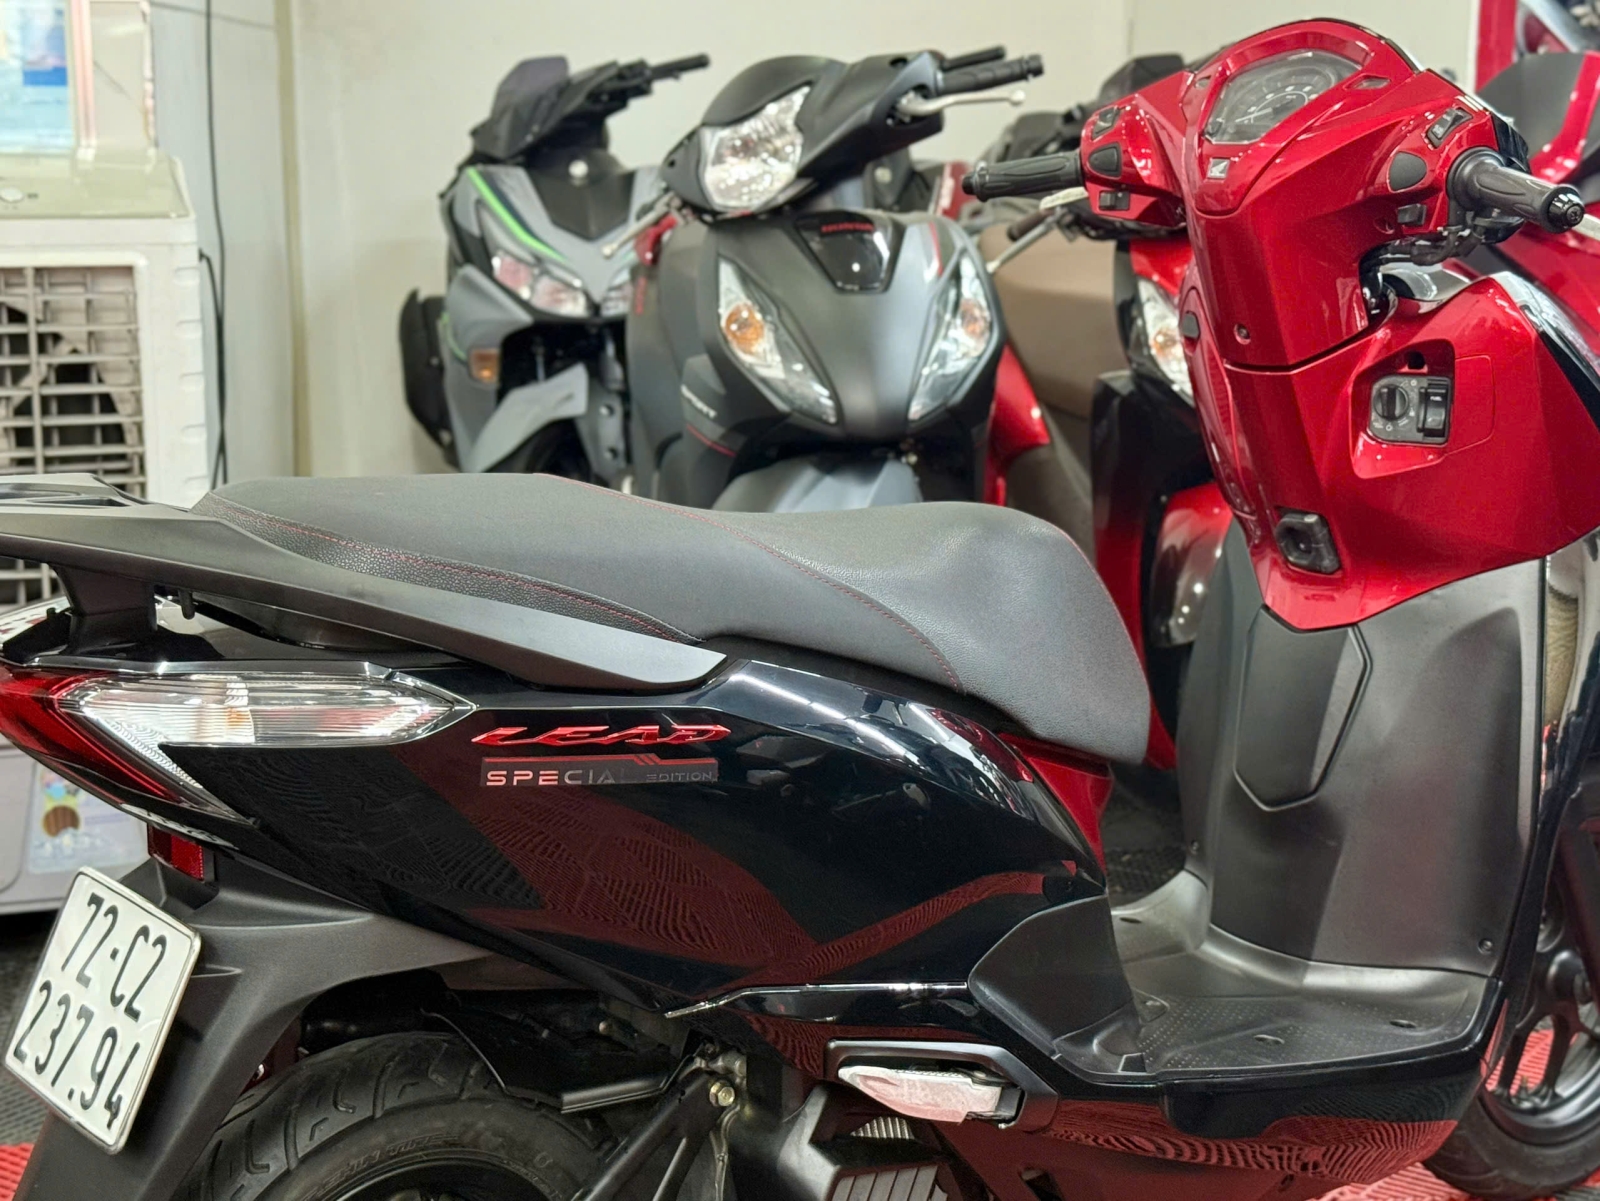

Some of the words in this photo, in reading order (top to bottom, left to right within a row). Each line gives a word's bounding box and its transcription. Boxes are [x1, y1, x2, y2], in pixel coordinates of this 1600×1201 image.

[471, 725, 732, 746] LEAD
[486, 768, 637, 786] SPECIAL
[646, 771, 713, 782] EDITION
[13, 979, 141, 1131] 237.94
